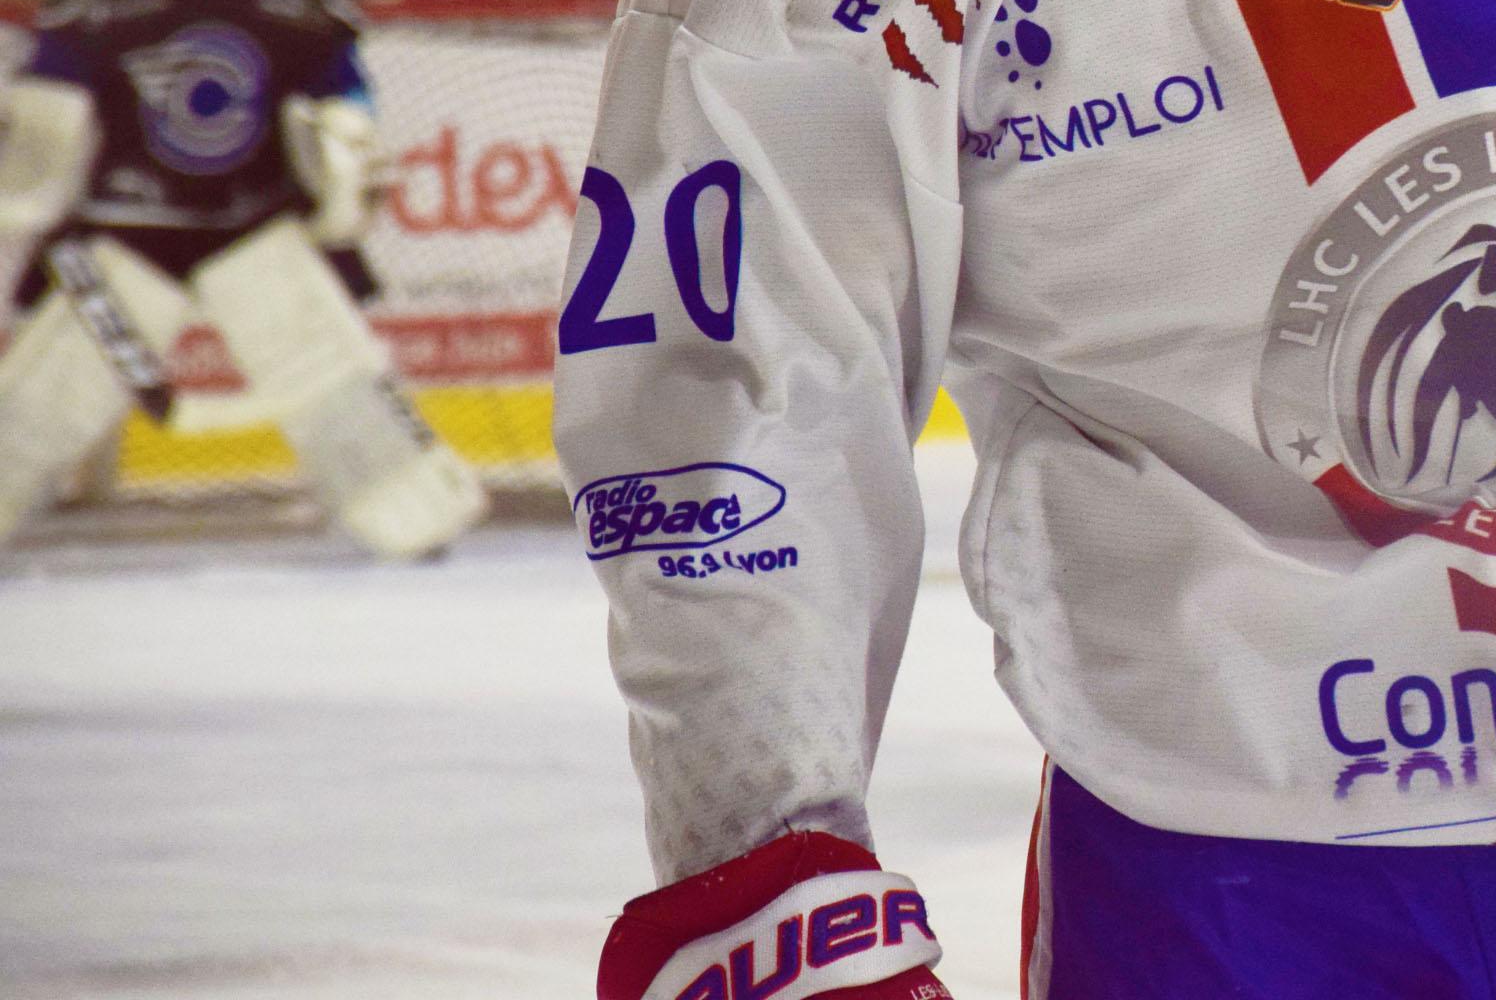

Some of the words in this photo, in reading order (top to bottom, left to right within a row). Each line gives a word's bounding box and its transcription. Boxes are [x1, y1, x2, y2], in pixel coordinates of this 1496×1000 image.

[559, 160, 742, 355] 20
[1279, 238, 1359, 348] LHC
[1353, 145, 1463, 238] LES
[586, 480, 657, 514] radio
[590, 493, 741, 550] espace
[658, 552, 721, 578] 96.9
